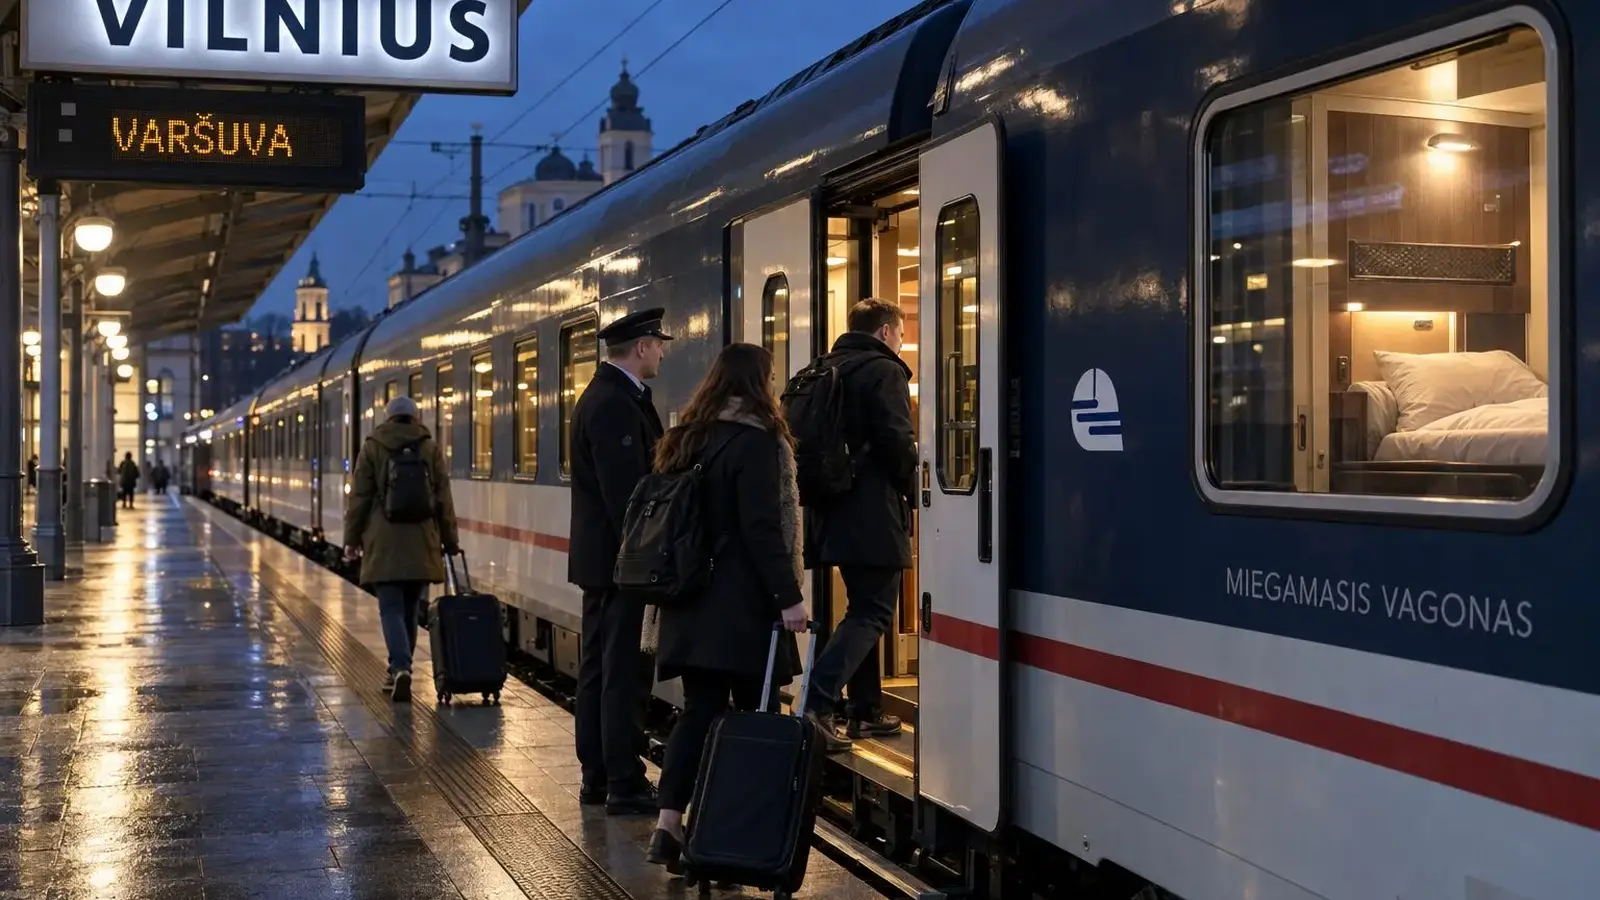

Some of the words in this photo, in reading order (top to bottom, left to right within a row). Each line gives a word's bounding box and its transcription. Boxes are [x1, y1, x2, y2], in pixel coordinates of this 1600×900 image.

[96, 0, 490, 62] VILNIUS
[112, 113, 293, 157] VARŠUVA
[1226, 567, 1371, 614] MIEGAMASIS
[1382, 585, 1533, 637] VAGONAS
